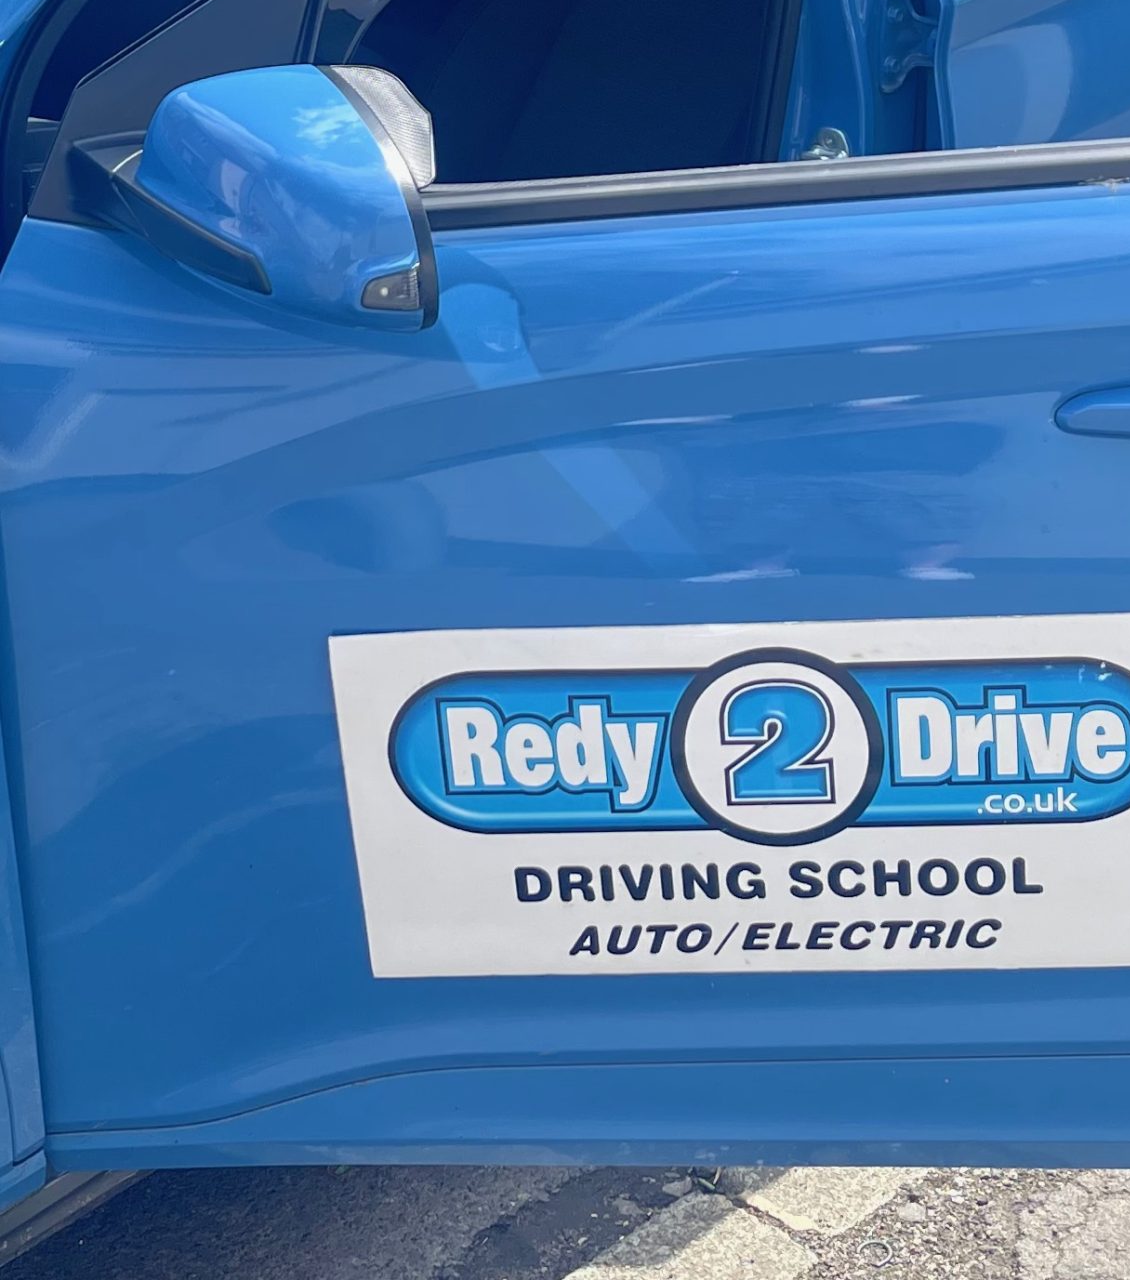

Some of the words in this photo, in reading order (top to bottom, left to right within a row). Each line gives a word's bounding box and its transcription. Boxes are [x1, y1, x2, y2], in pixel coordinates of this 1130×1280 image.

[444, 702, 661, 805] Redy
[720, 677, 836, 806] 2
[891, 694, 1129, 780] Drive
[976, 787, 1078, 815] .co.uk
[513, 860, 767, 903] DRIVING
[788, 857, 1044, 899] SCHOOL
[569, 918, 1003, 957] AUTO/ELECTRIC
